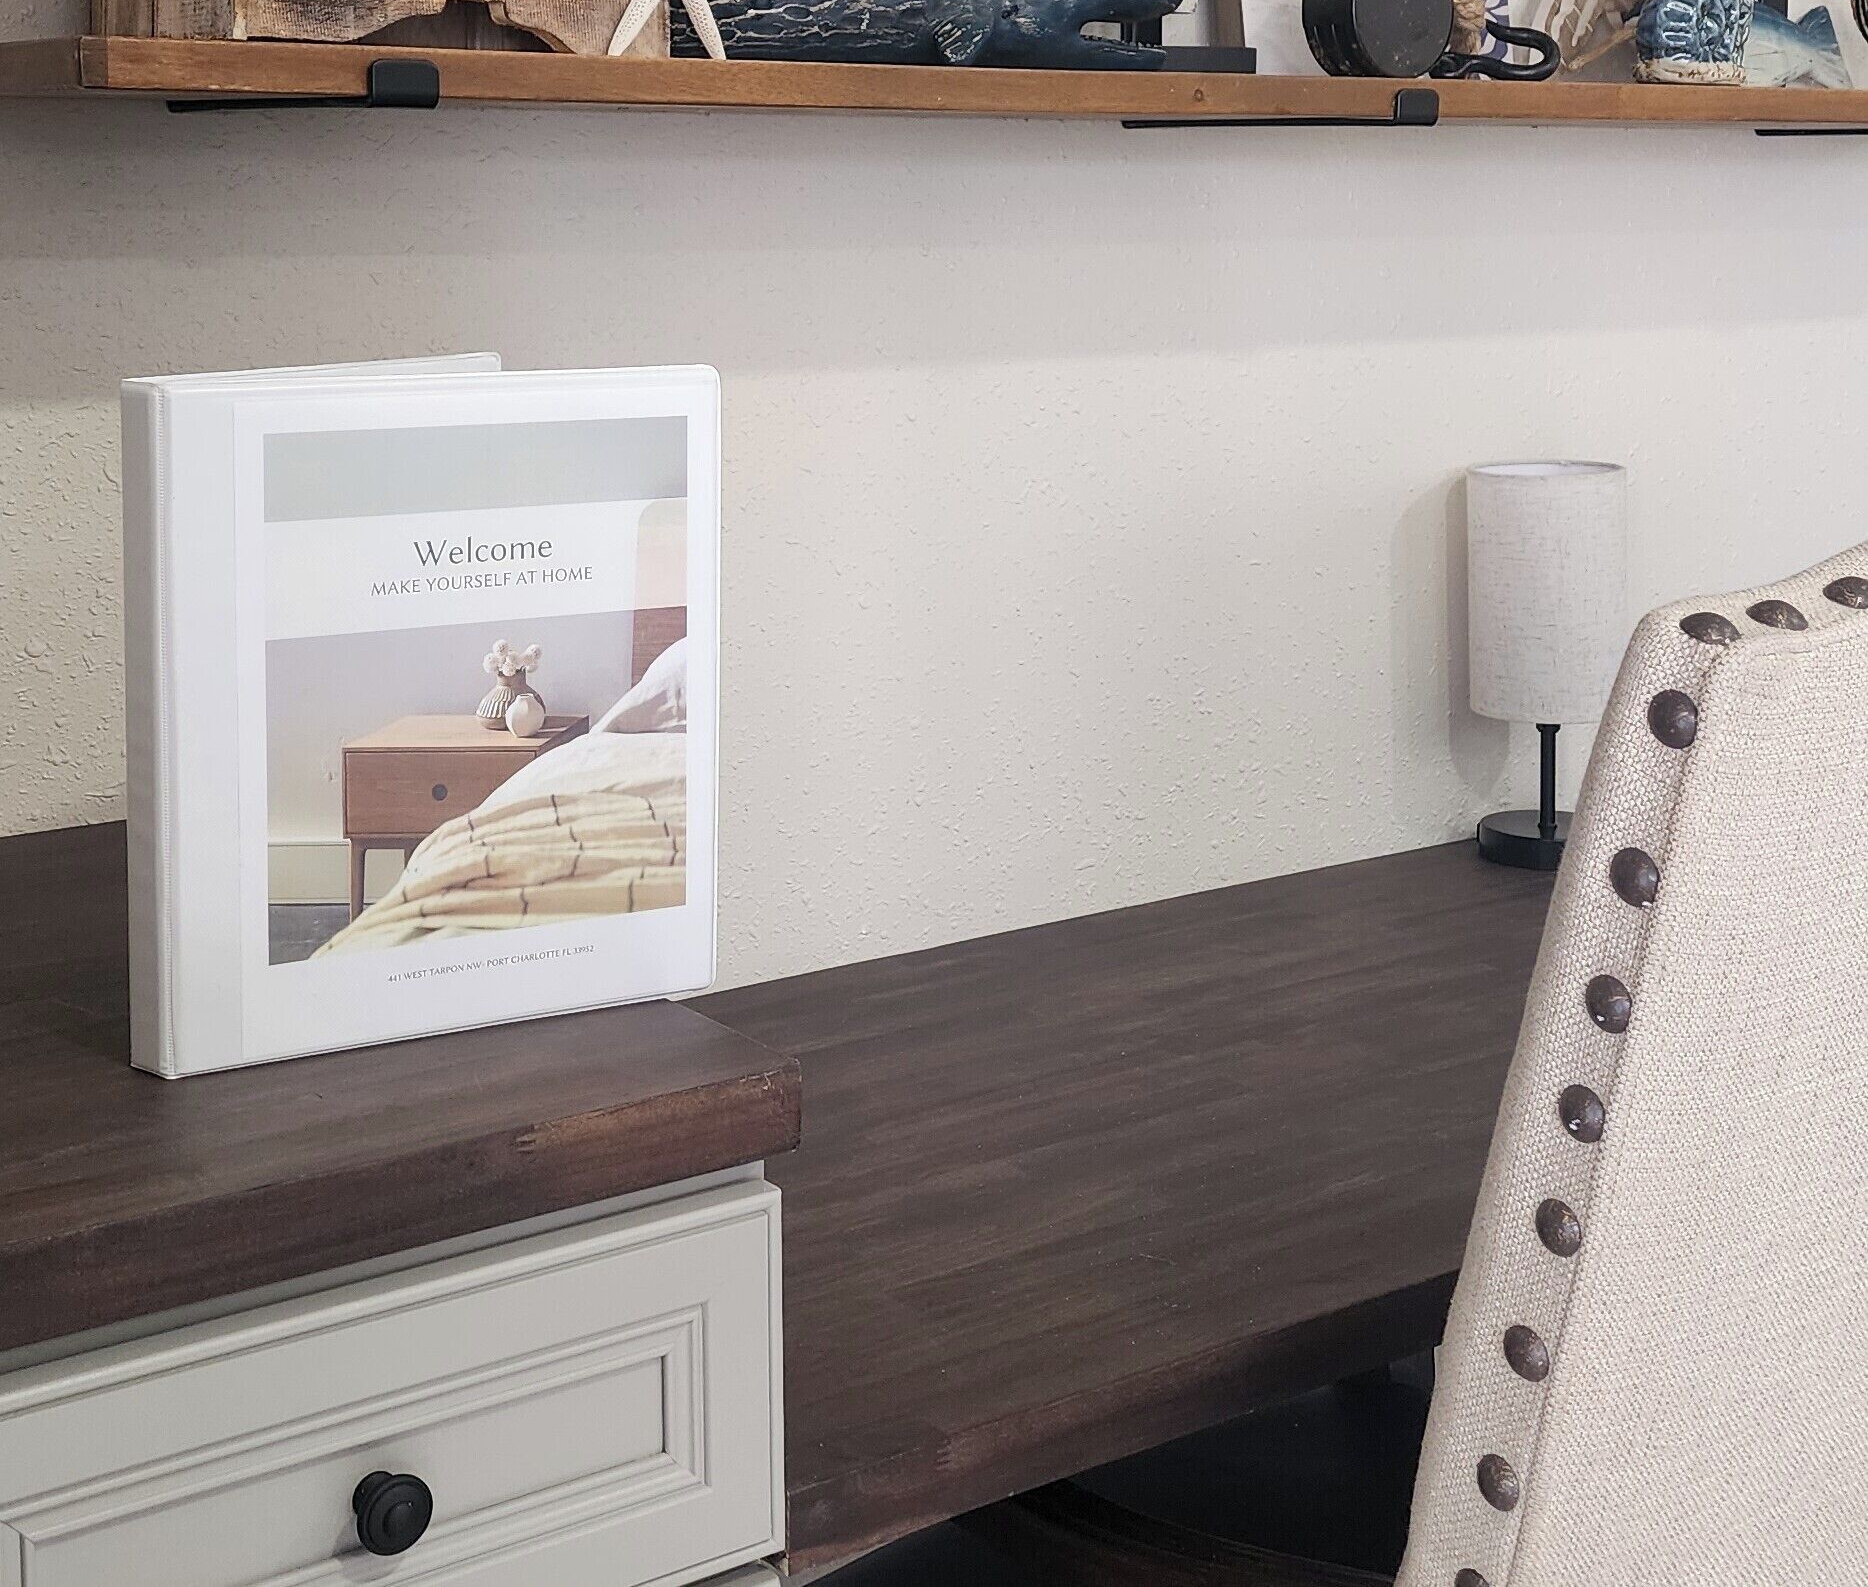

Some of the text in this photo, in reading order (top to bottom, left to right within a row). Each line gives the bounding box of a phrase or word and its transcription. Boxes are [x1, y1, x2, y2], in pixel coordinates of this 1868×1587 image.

[413, 535, 553, 567] Welcome
[371, 566, 594, 596] MAKE YOURSELF AT HOME
[403, 969, 427, 979] WEST
[429, 964, 465, 976] TARPON
[486, 957, 509, 967] PORT
[510, 949, 560, 964] CHARLOTTE
[562, 947, 572, 956] FL
